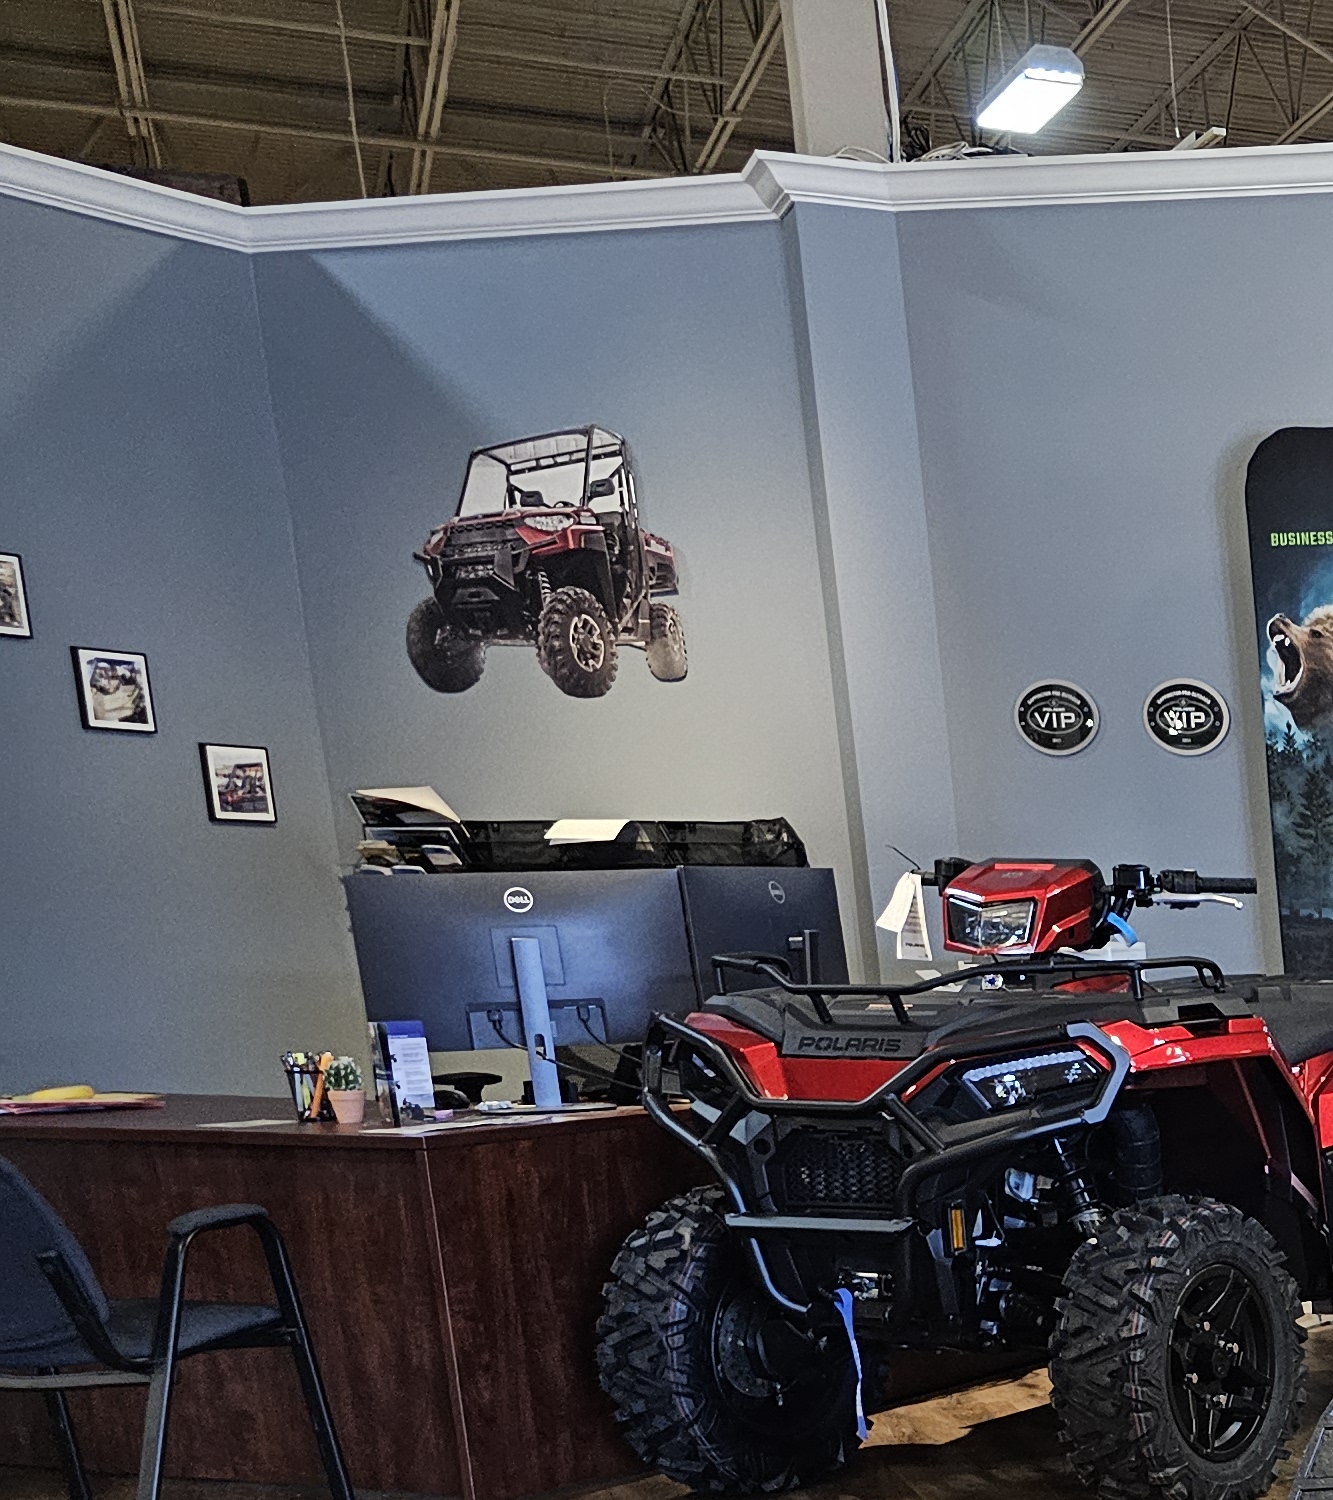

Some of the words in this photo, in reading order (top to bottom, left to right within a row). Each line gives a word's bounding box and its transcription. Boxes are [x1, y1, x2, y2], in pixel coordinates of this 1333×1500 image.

[1270, 530, 1333, 547] BUSINESS
[1034, 711, 1067, 729] VIP
[1163, 711, 1206, 729] VIP
[507, 895, 531, 906] DELL
[798, 1035, 903, 1052] POLARIS
